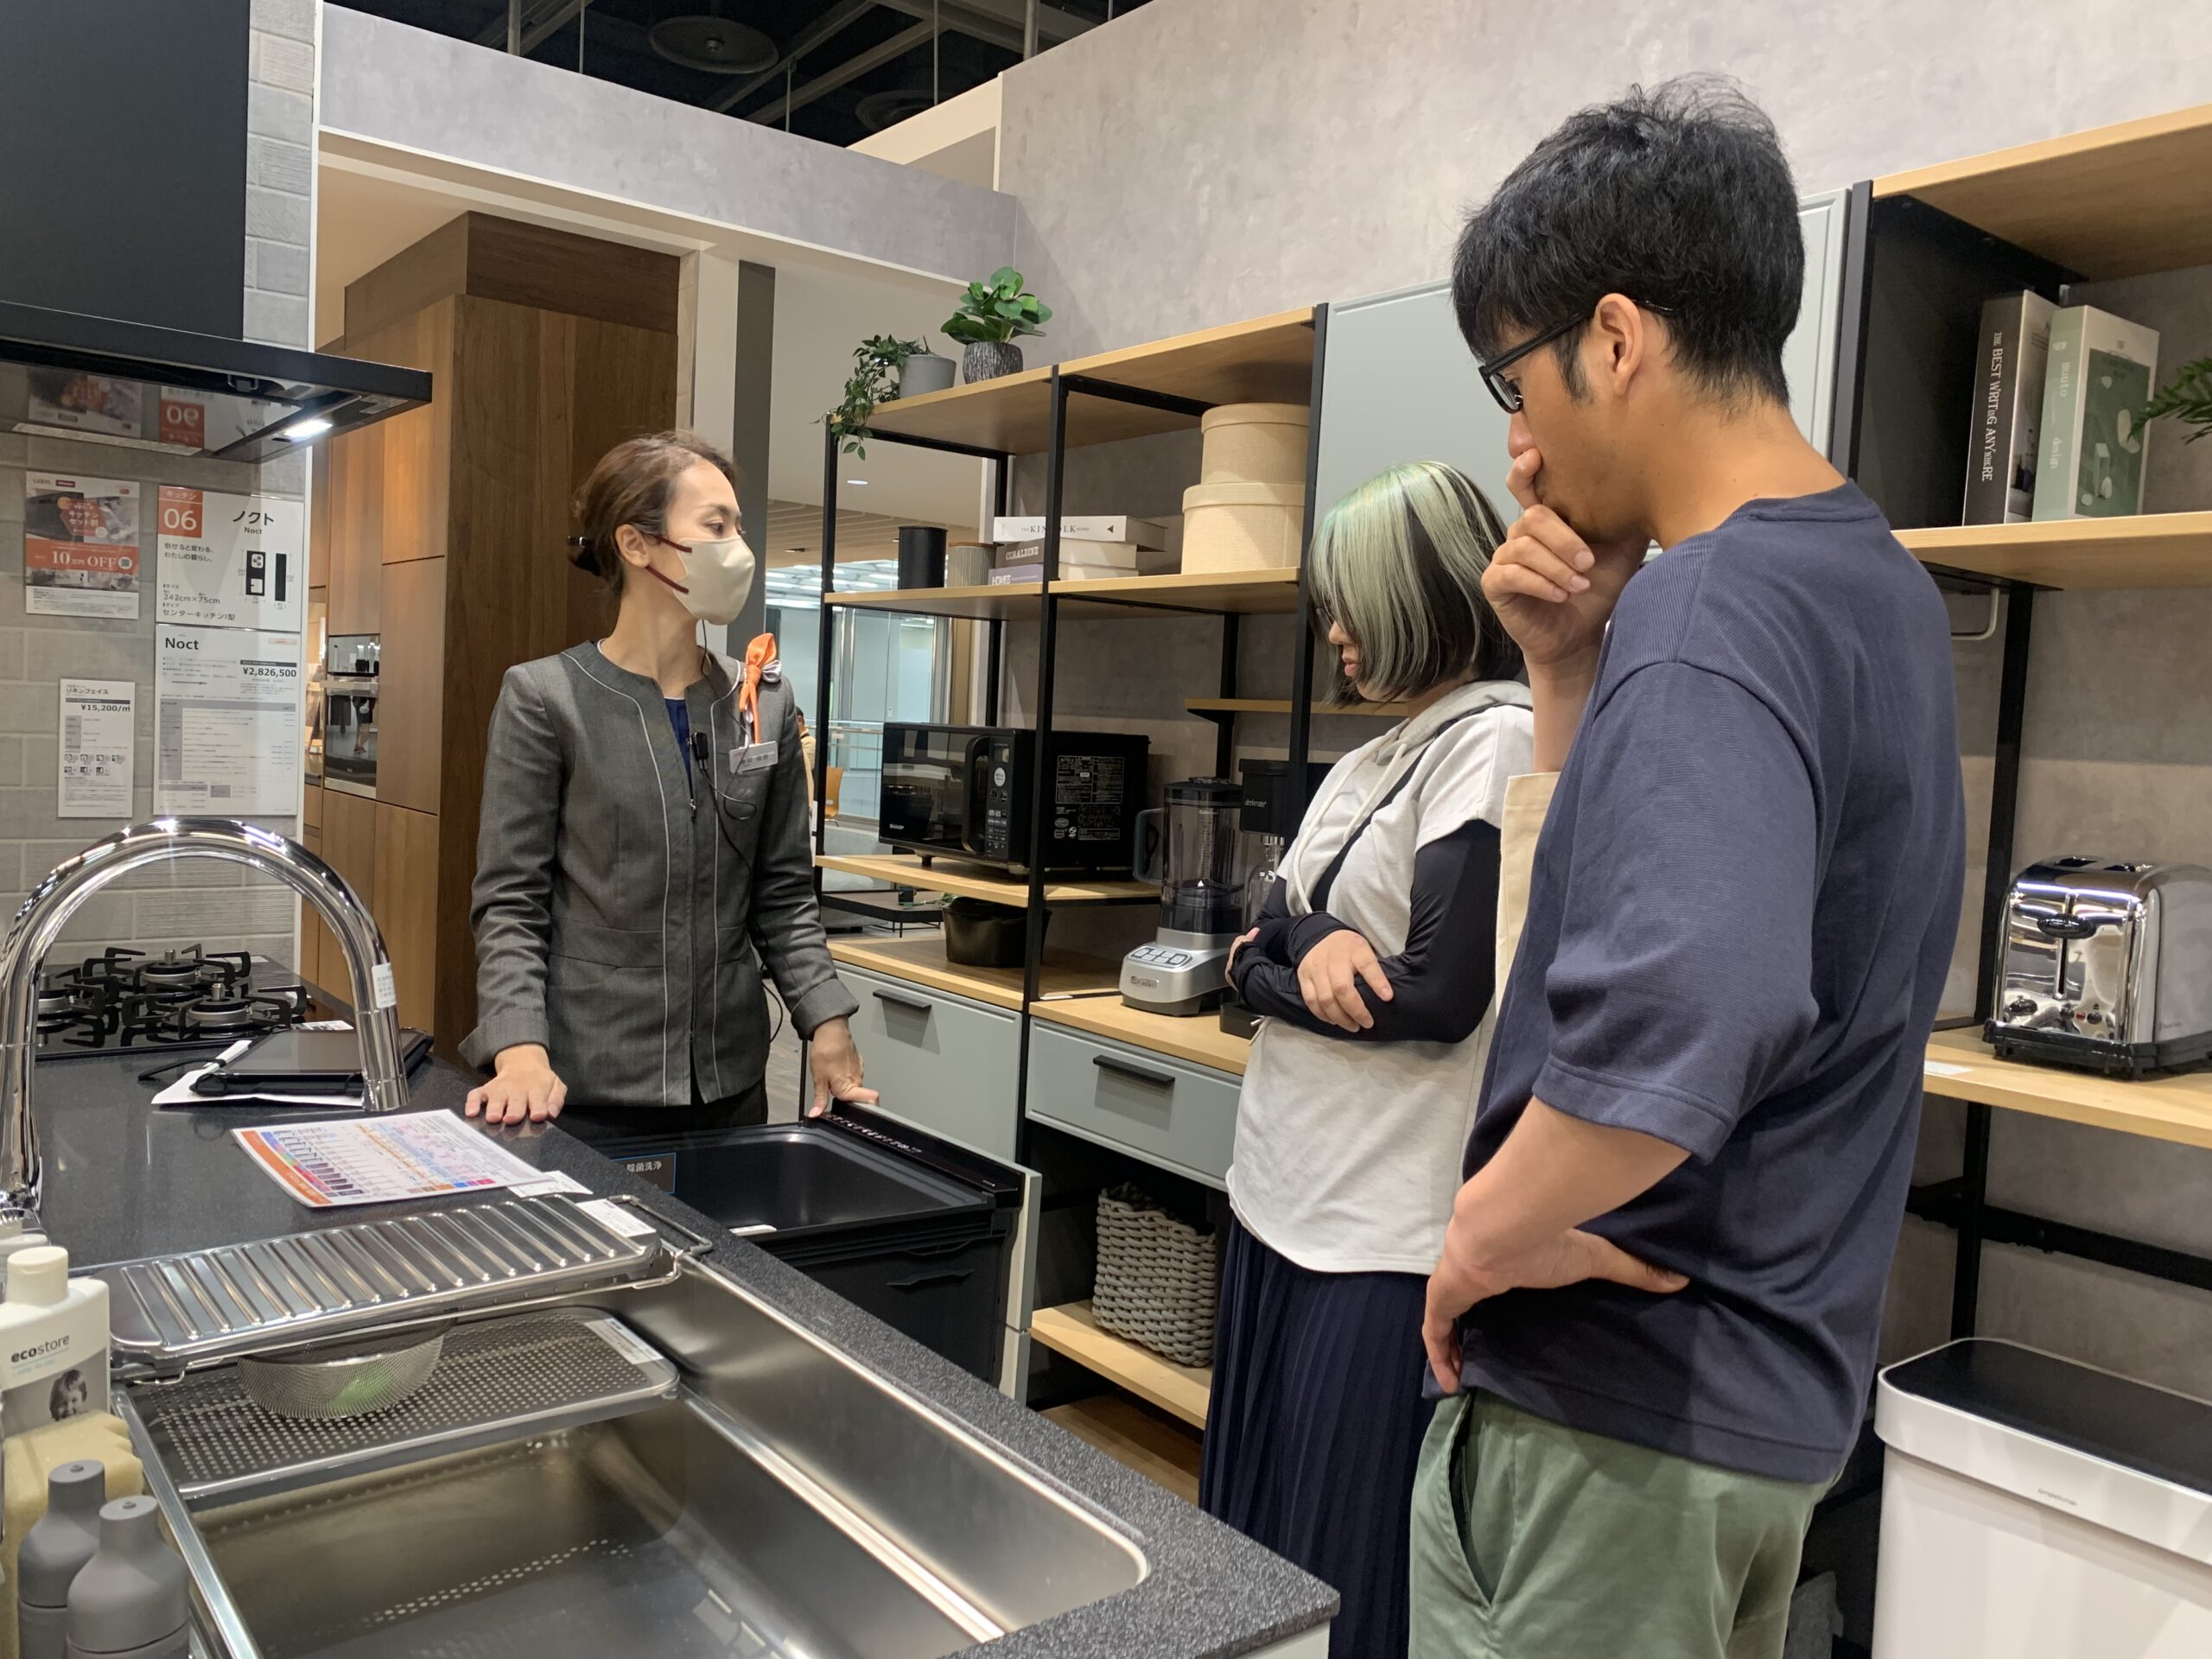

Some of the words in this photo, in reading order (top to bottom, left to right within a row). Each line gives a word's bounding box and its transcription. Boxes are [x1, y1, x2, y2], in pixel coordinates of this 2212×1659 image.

[1993, 332, 2002, 346] THE
[1991, 348, 2003, 378] BEST
[2060, 361, 2070, 397] muuto
[1986, 380, 2001, 424] WRITING
[1981, 428, 1996, 481] ANYWHERE
[165, 490, 197, 500] キッチン
[164, 508, 197, 531] 06
[232, 511, 275, 526] ノクト
[244, 526, 263, 535] Noct
[53, 551, 70, 564] 10
[87, 556, 117, 568] OFF
[165, 637, 199, 650] Noct
[243, 667, 297, 677] ¥2,826,500
[626, 1160, 662, 1173] 除菌洗浄
[11, 1335, 69, 1363] ecostore
